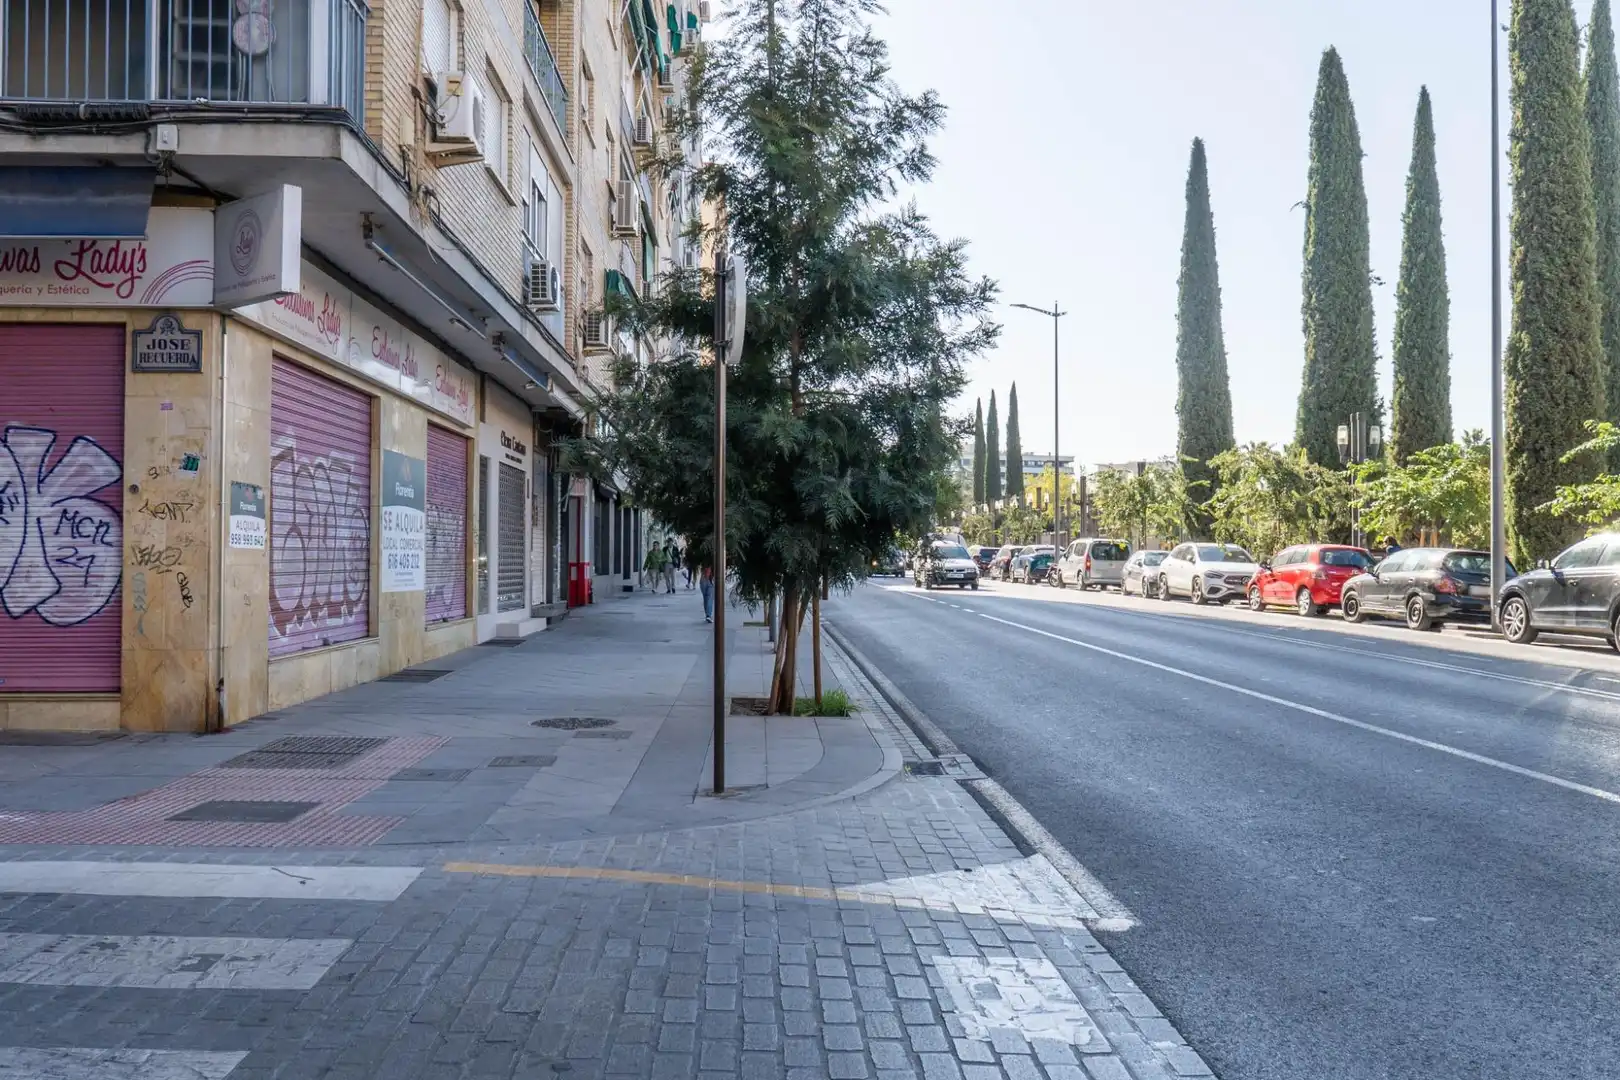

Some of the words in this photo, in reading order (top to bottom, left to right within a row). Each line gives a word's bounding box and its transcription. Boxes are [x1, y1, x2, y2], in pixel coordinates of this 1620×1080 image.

[0, 247, 41, 273] vas
[54, 240, 147, 299] Lady's
[47, 284, 90, 295] Estética
[146, 338, 191, 350] JOSE
[139, 352, 197, 364] RECUERDA
[236, 519, 260, 532] ALQUILA
[383, 510, 392, 531] SE
[395, 512, 423, 535] ALQUILA
[231, 533, 241, 545] 958
[383, 537, 397, 550] LOCAL
